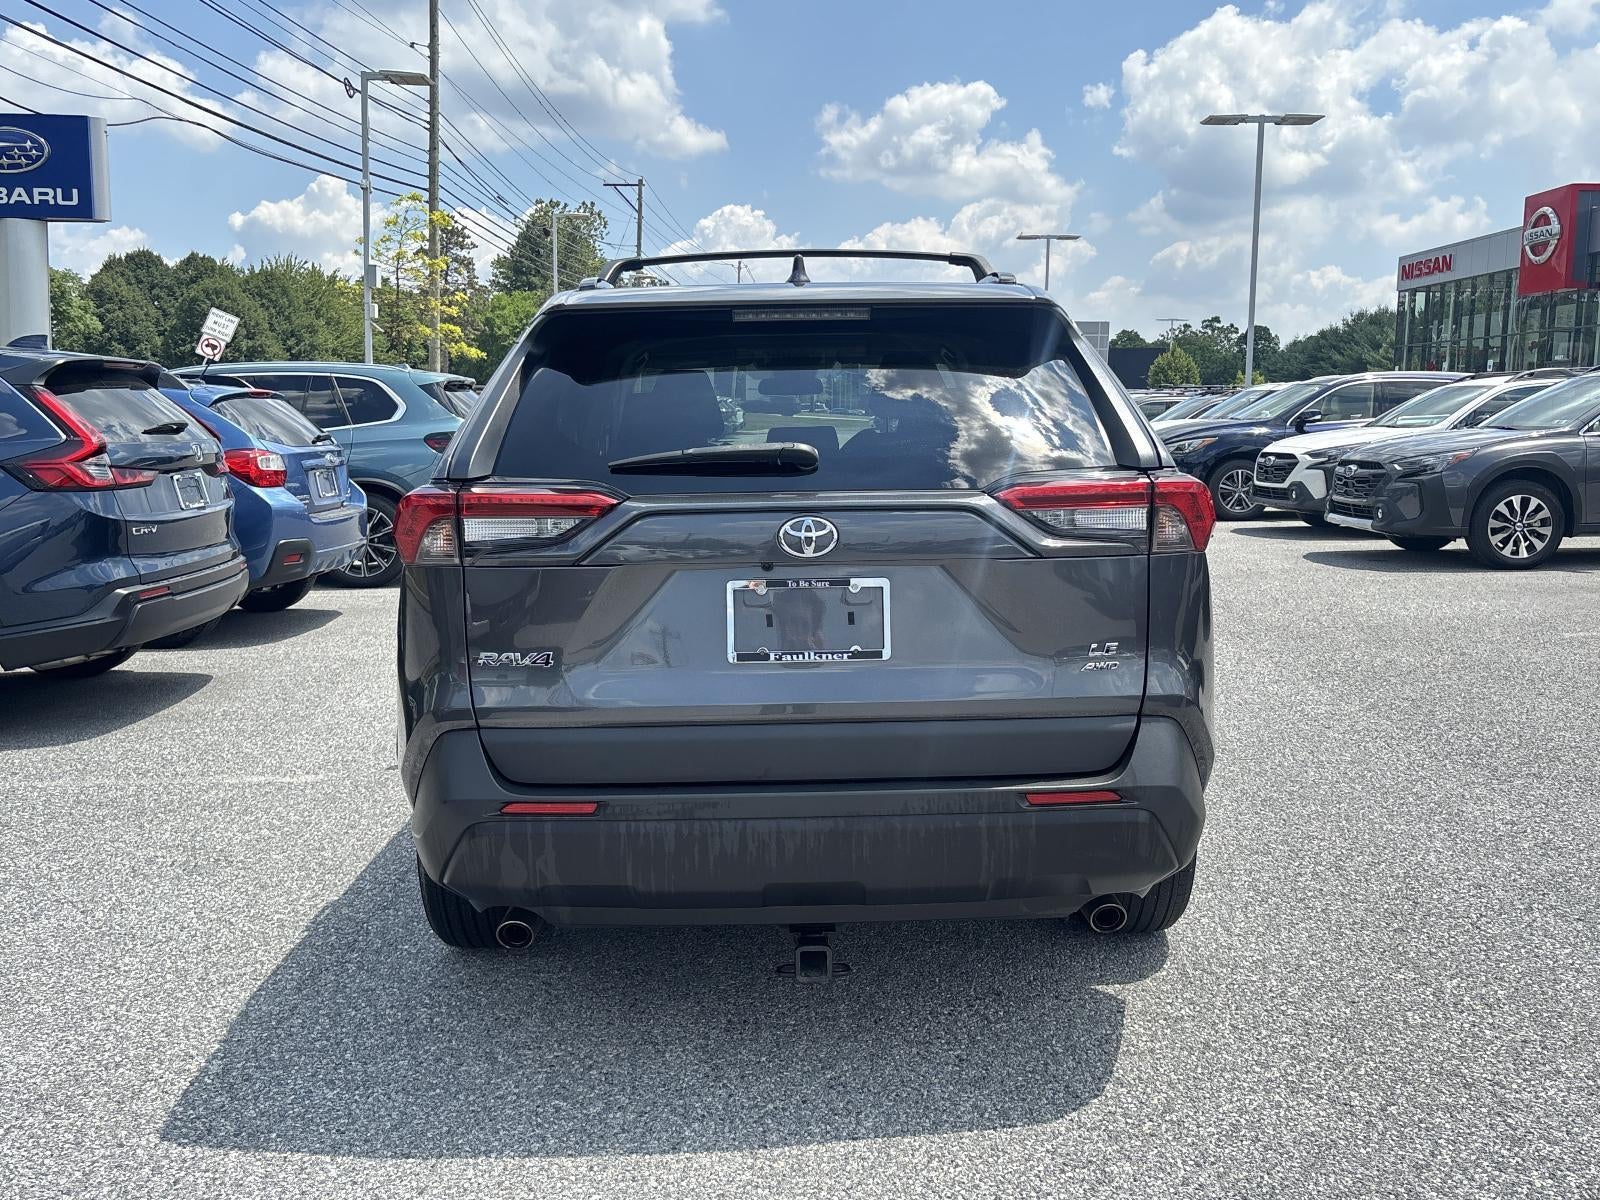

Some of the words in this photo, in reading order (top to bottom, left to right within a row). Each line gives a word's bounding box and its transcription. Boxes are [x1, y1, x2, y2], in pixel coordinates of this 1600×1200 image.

[1524, 228, 1553, 241] NISSAN
[1401, 254, 1453, 281] NISSAN
[213, 320, 229, 330] MUST
[132, 524, 158, 535] CR-V
[787, 580, 797, 588] To
[799, 580, 809, 588] Be
[1088, 642, 1119, 656] LE
[477, 651, 554, 668] RAV4
[768, 651, 852, 661] Faulkner
[1080, 661, 1120, 671] AWD
